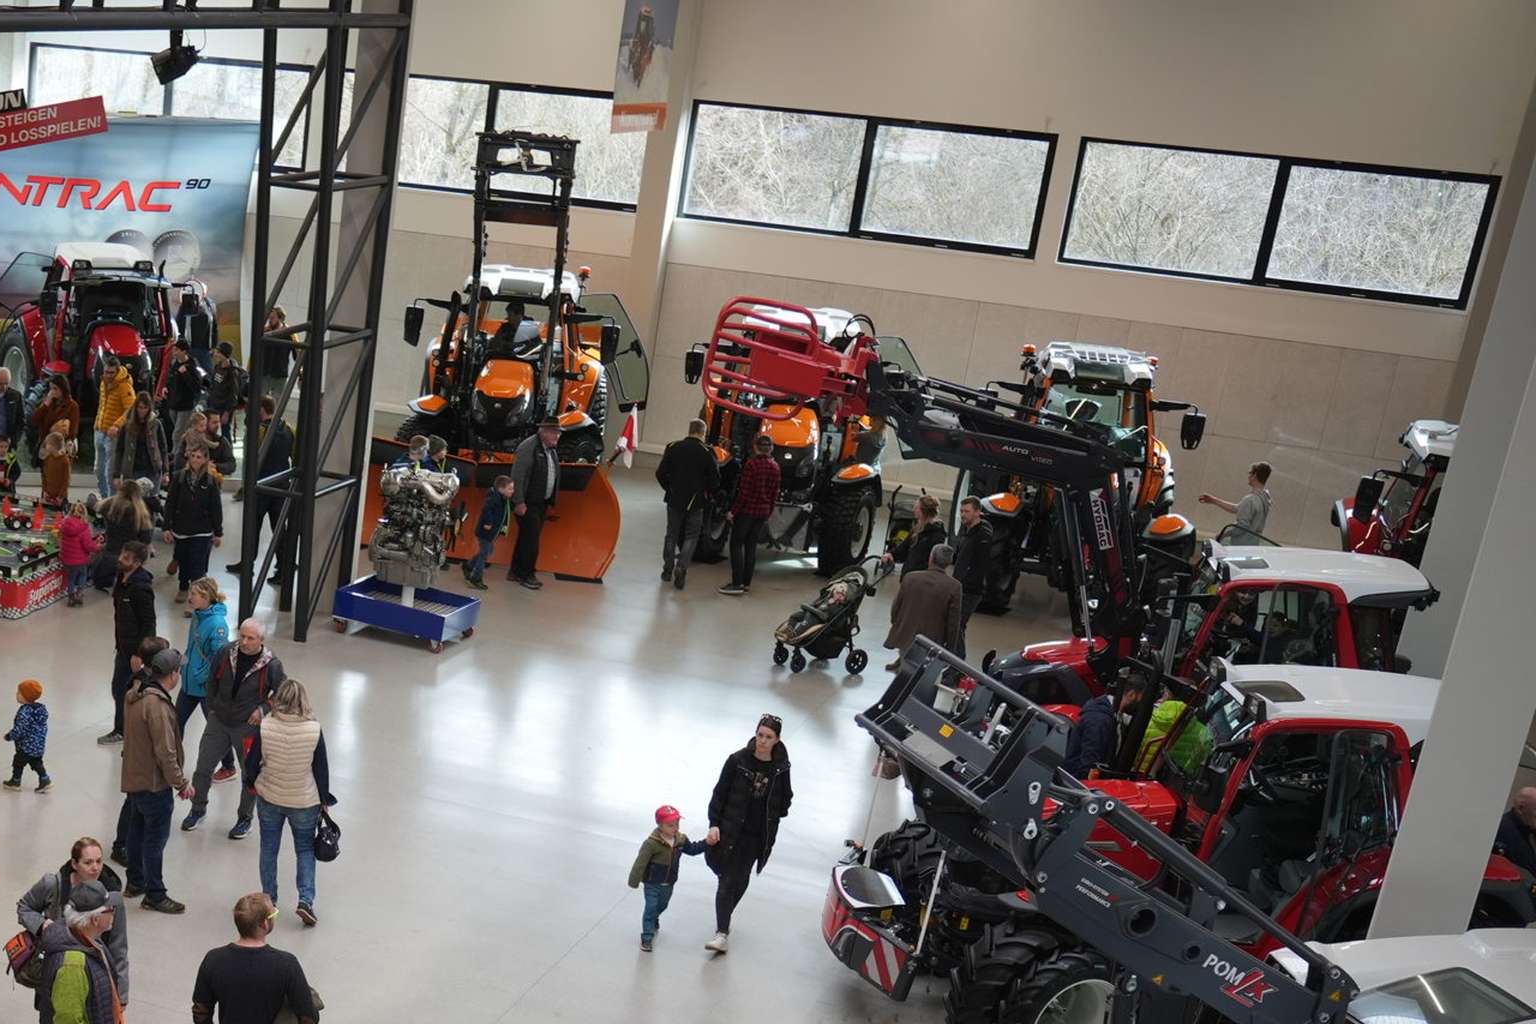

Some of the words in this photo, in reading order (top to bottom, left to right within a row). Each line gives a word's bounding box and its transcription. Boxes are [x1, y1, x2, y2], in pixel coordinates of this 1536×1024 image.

[11, 115, 102, 144] LOSSPIELEN!
[184, 178, 212, 190] 90
[1090, 499, 1109, 548] HYDRAC
